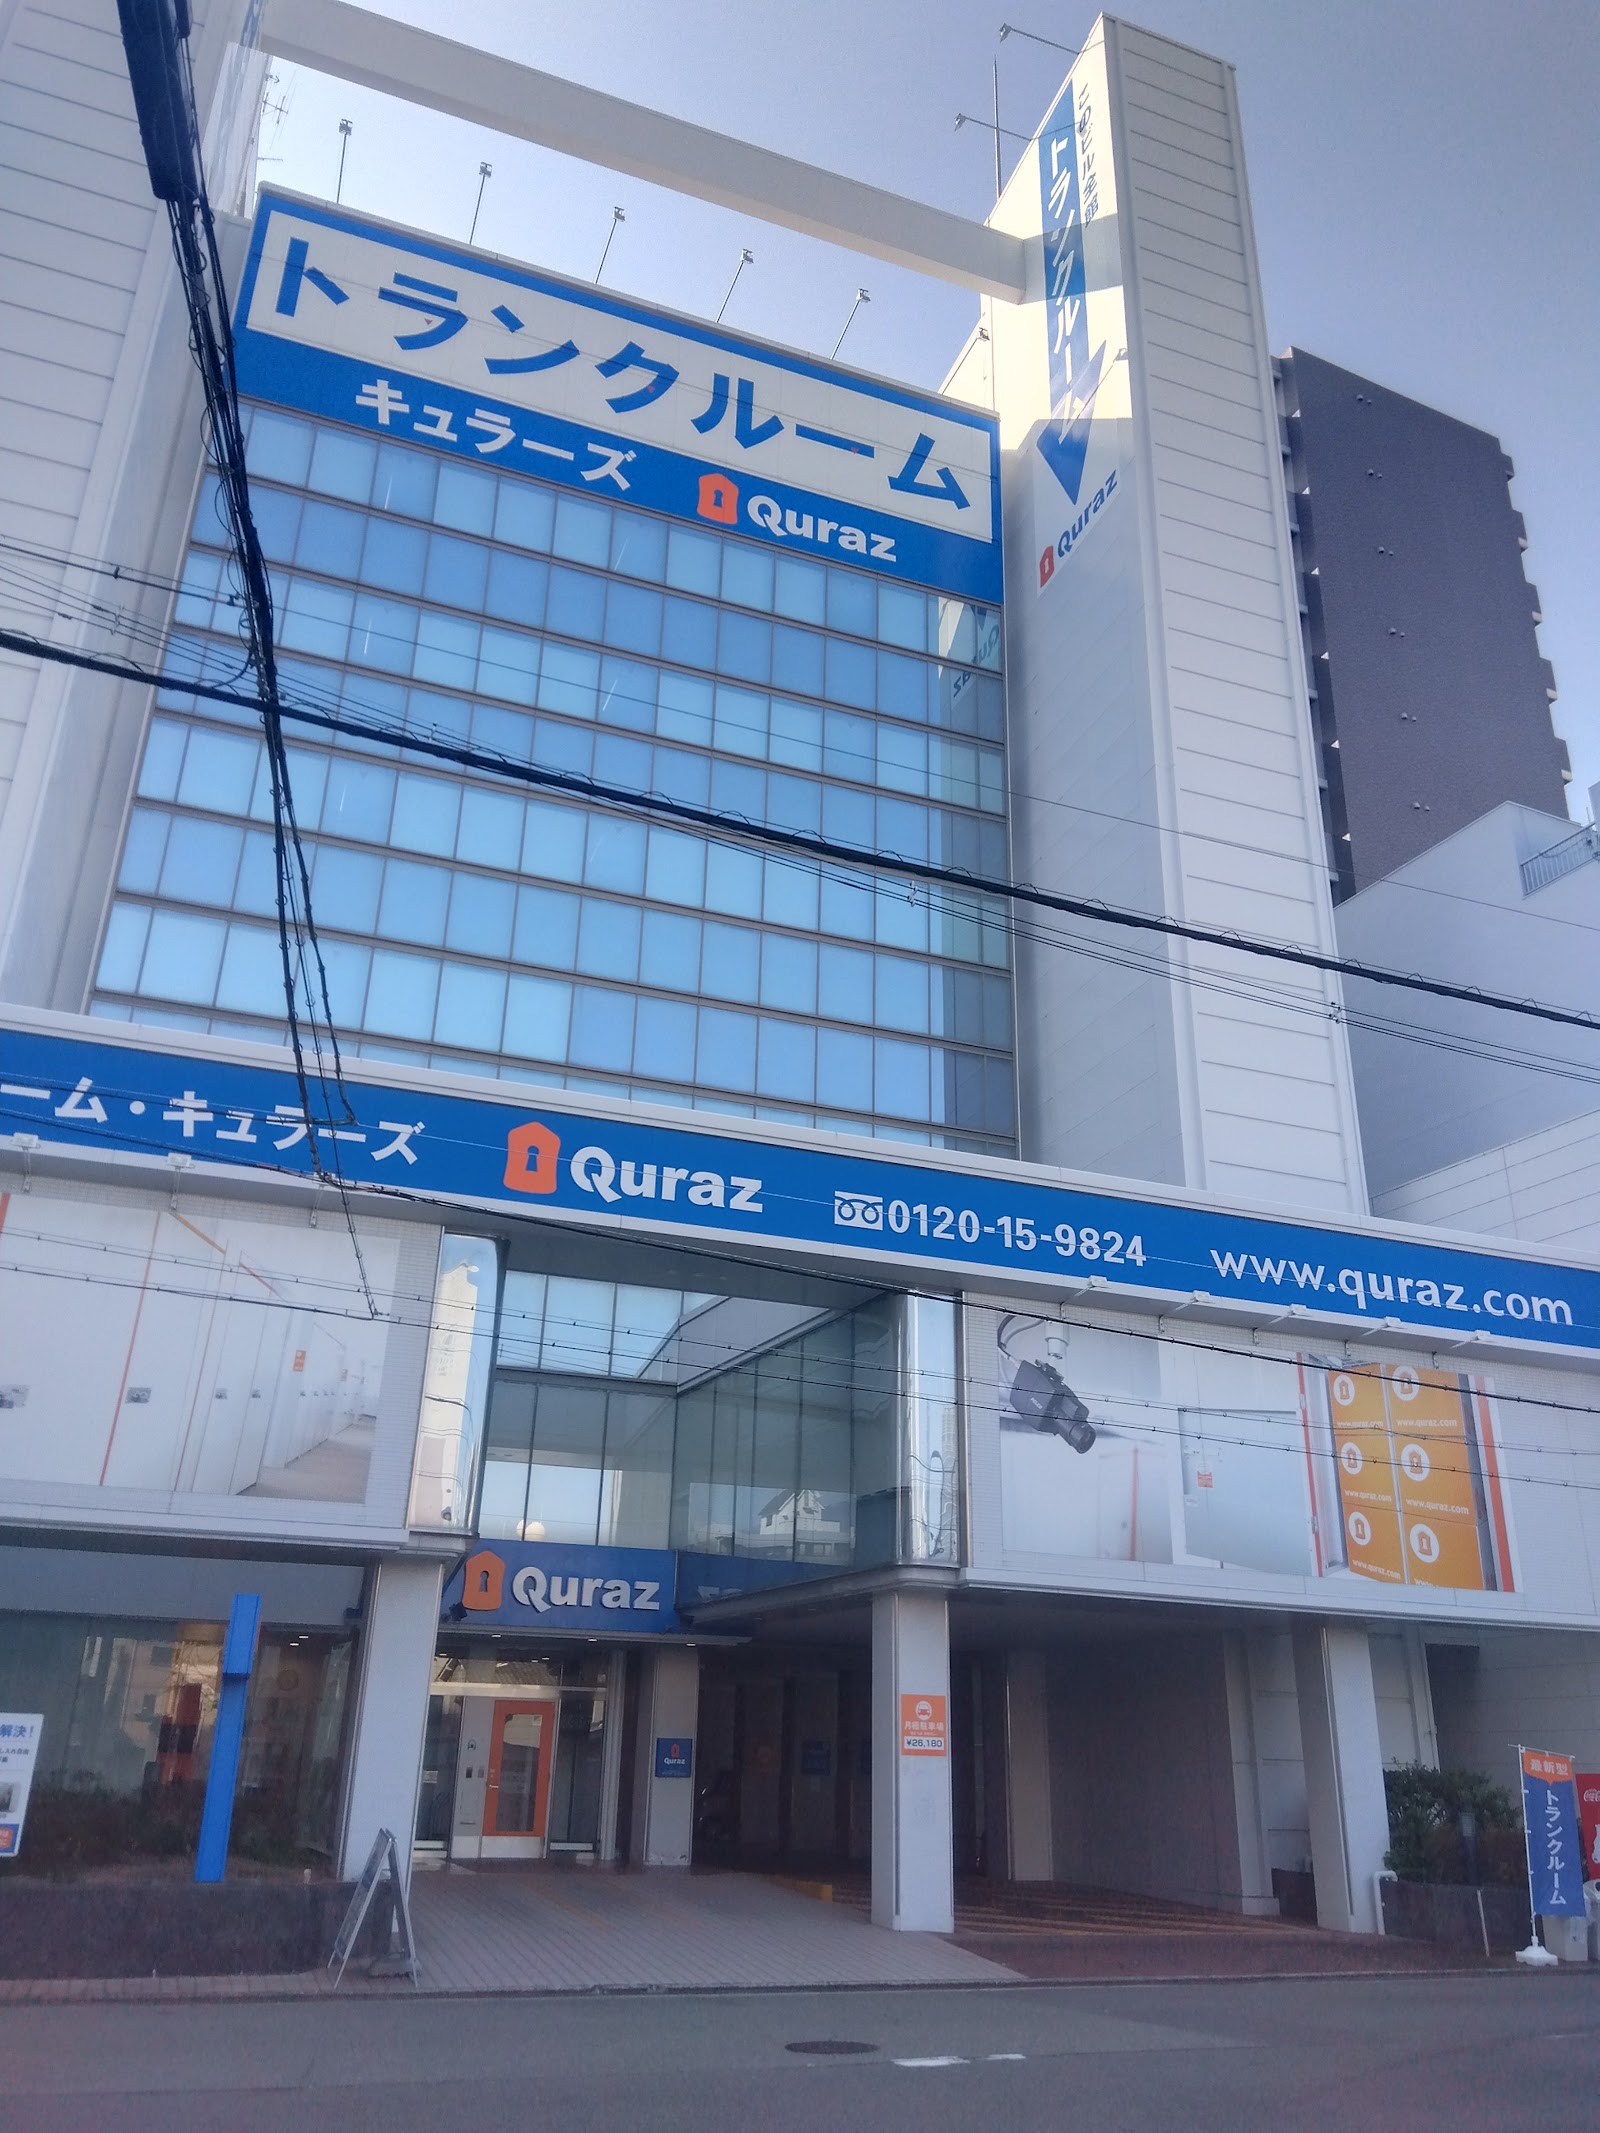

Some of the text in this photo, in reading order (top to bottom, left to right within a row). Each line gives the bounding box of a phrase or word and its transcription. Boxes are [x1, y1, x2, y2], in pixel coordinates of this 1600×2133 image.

[1048, 137, 1086, 444] トランクルーム
[274, 236, 970, 511] トランクルーム
[354, 379, 636, 493] キュラーズ
[746, 493, 897, 563] Quraz
[1057, 469, 1118, 558] Quraz
[569, 1145, 765, 1213] Quraz
[887, 1199, 1147, 1268] 0120-15-9824
[1209, 1248, 1575, 1327] www.quraz.com
[1396, 1418, 1457, 1428] www.quraz.com
[1344, 1489, 1392, 1502] www.quraz.com
[1405, 1498, 1470, 1515] www.quraz.com
[512, 1566, 661, 1615] Quraz
[1352, 1559, 1402, 1580] www.quraz.com
[663, 1757, 686, 1765] Quraz
[906, 1738, 943, 1748] ¥26,180
[1530, 1758, 1568, 1776] 最新型
[1545, 1789, 1567, 1905] トランクルーム
